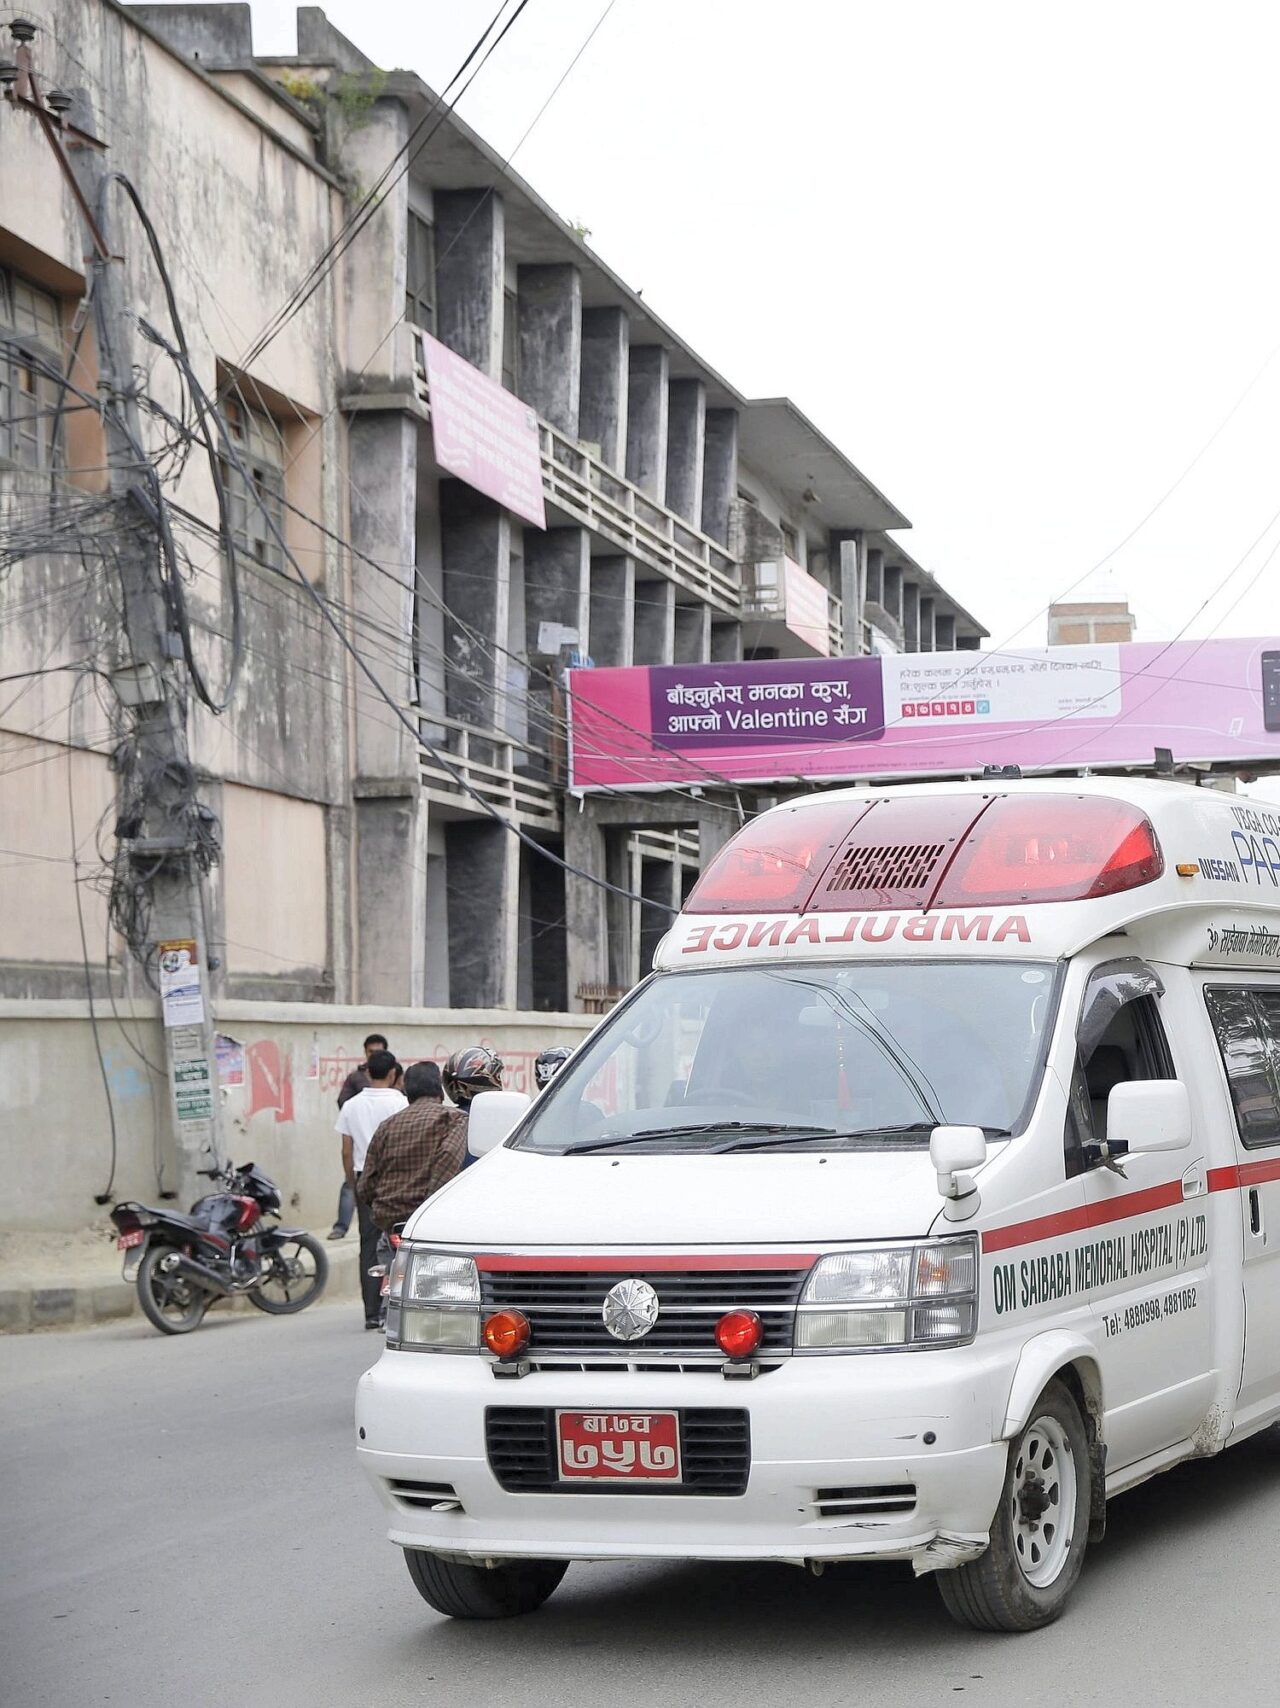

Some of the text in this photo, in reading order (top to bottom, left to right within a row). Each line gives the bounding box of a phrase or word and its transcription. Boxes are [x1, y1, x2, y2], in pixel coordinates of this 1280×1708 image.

[748, 682, 804, 702] मनका
[810, 680, 852, 704] कुरा,
[668, 703, 867, 733] आफ्नो Valentine सँग
[1198, 857, 1241, 883] NISSAN
[993, 1263, 1017, 1315] OM
[1020, 1251, 1072, 1308] SAIBABA
[1075, 1236, 1128, 1293] MEMORIAL
[1130, 1223, 1173, 1276] HOSPITAL
[1190, 1214, 1208, 1257] LTD.
[1102, 1312, 1122, 1338] Tel:
[1163, 1287, 1197, 1317] 4881062
[562, 1439, 676, 1473] ७५७
